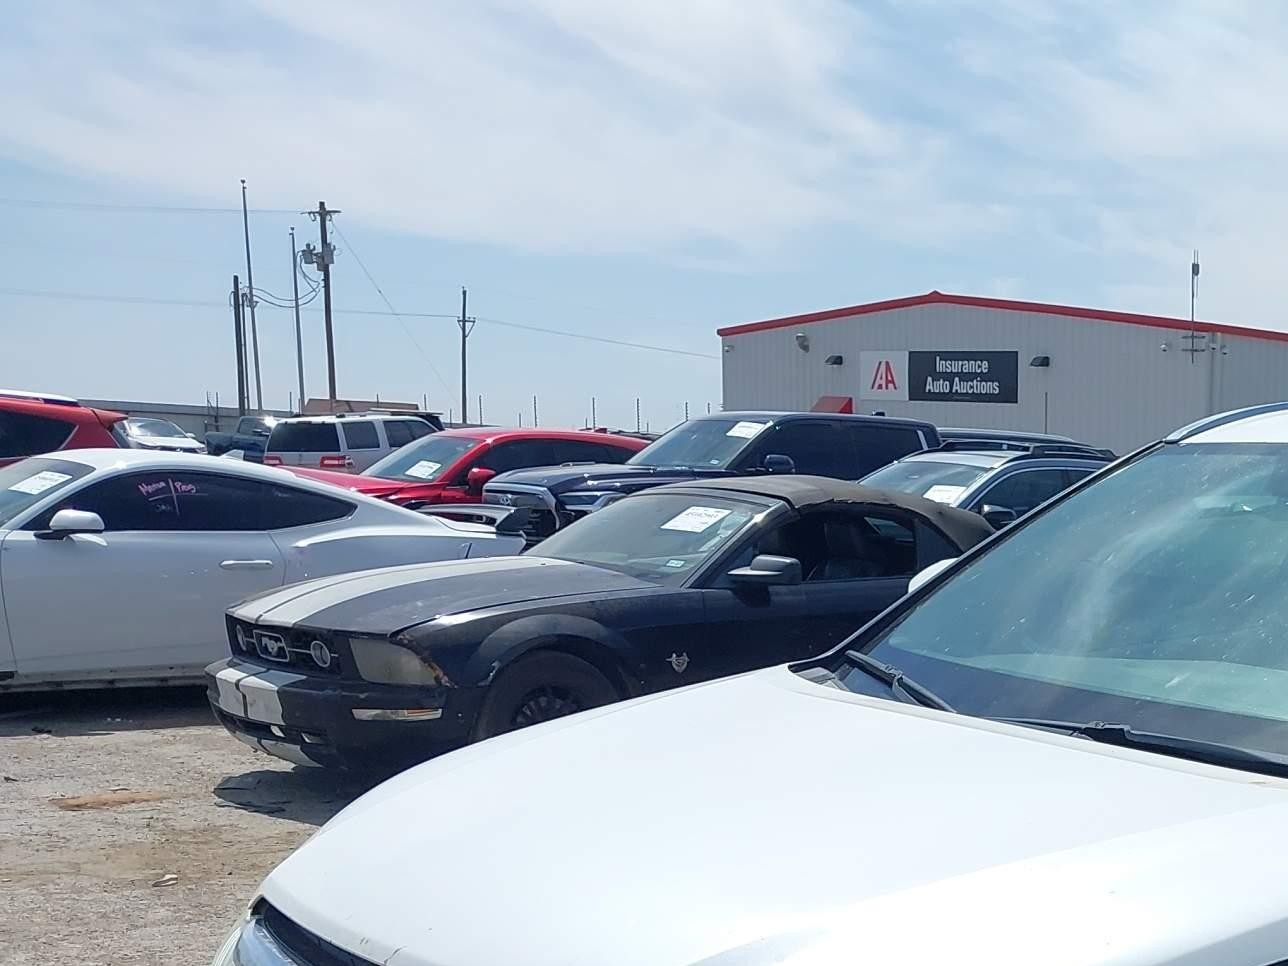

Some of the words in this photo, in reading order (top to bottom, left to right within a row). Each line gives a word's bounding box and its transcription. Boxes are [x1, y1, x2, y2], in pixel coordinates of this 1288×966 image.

[935, 355, 989, 373] Insurance
[925, 375, 950, 393] Auto
[952, 376, 1000, 394] Auctions
